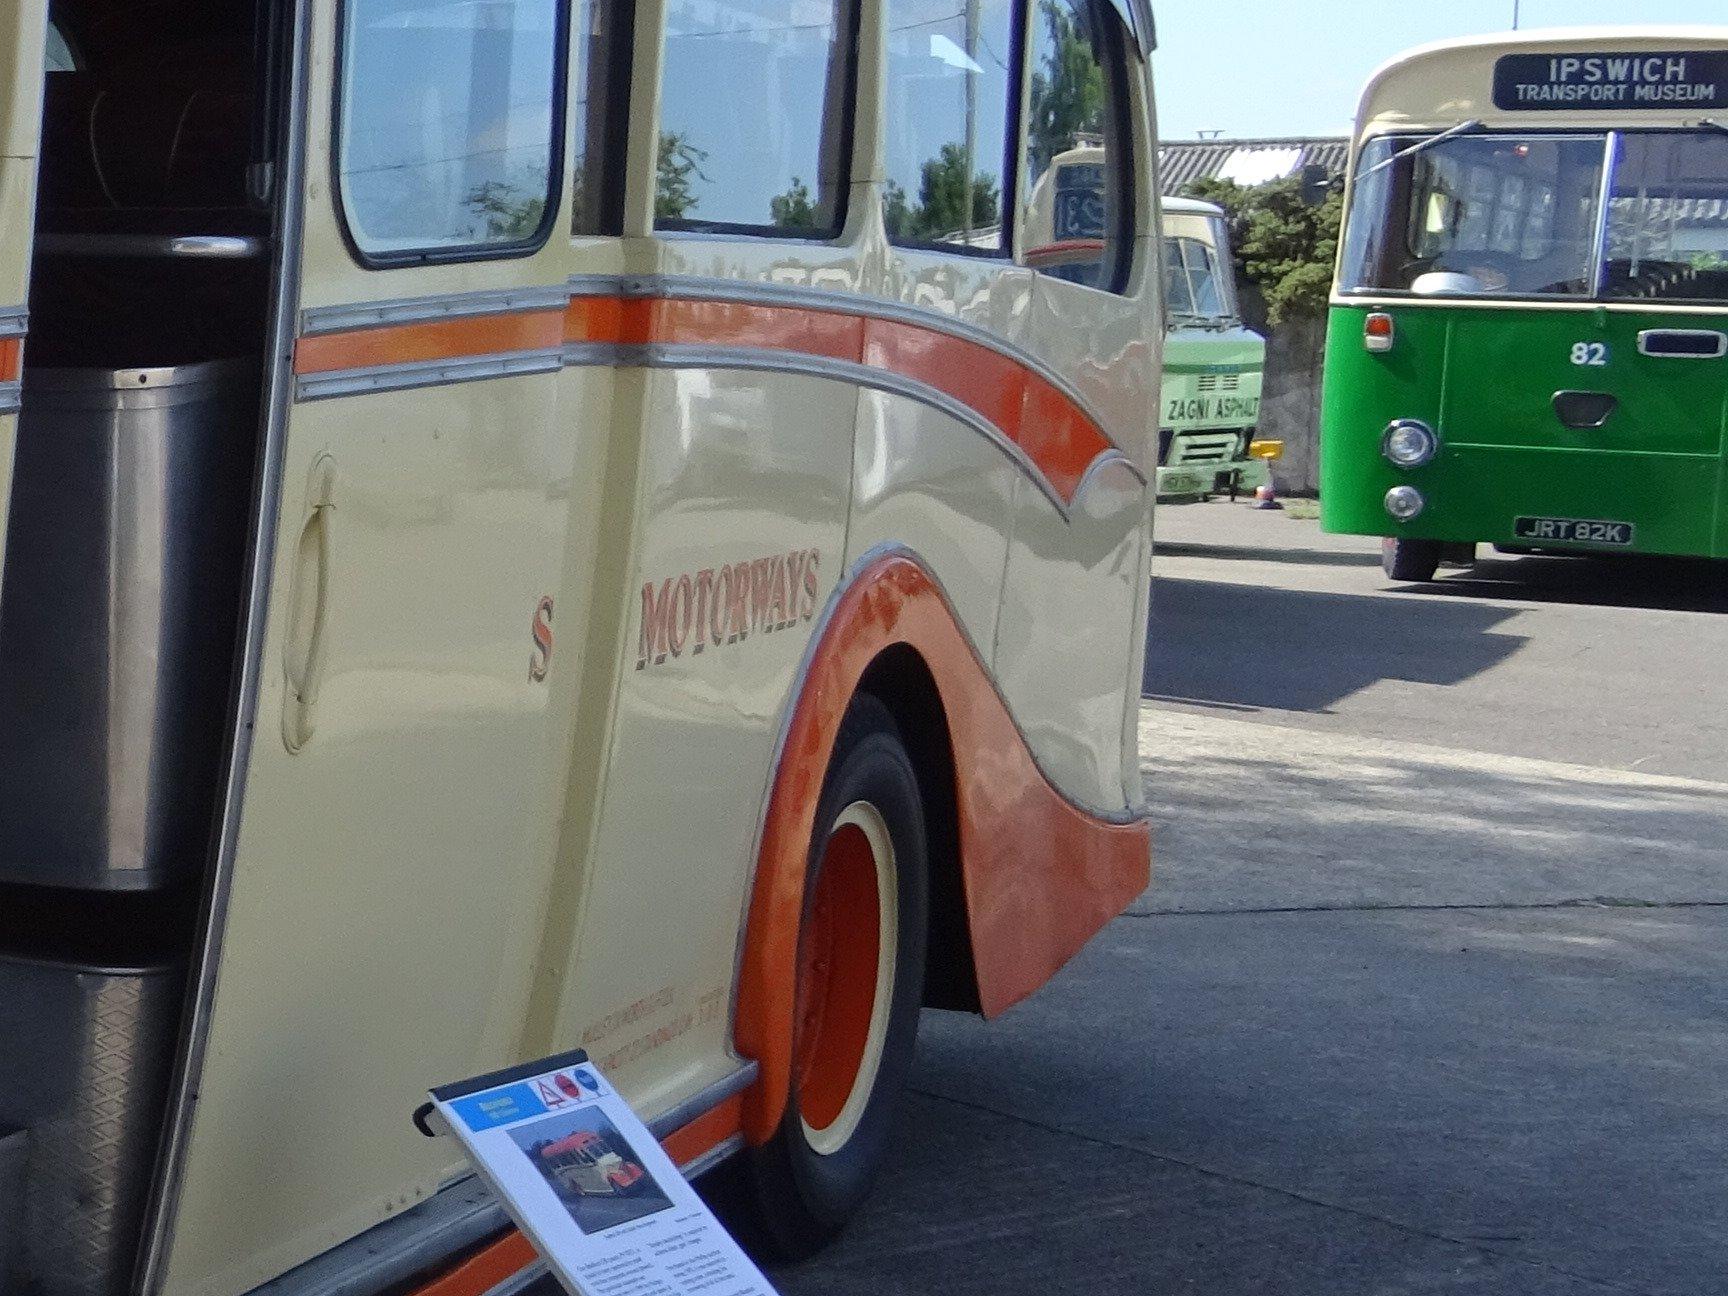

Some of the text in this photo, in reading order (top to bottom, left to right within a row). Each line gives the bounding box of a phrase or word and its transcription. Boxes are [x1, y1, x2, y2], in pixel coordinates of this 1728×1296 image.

[1549, 57, 1686, 82] IPSWICH
[1516, 83, 1715, 101] TRANSPORT MUSEUM
[1570, 341, 1606, 366] 82
[1525, 519, 1623, 542] JRT 82K
[636, 548, 820, 670] MOTORWAYS
